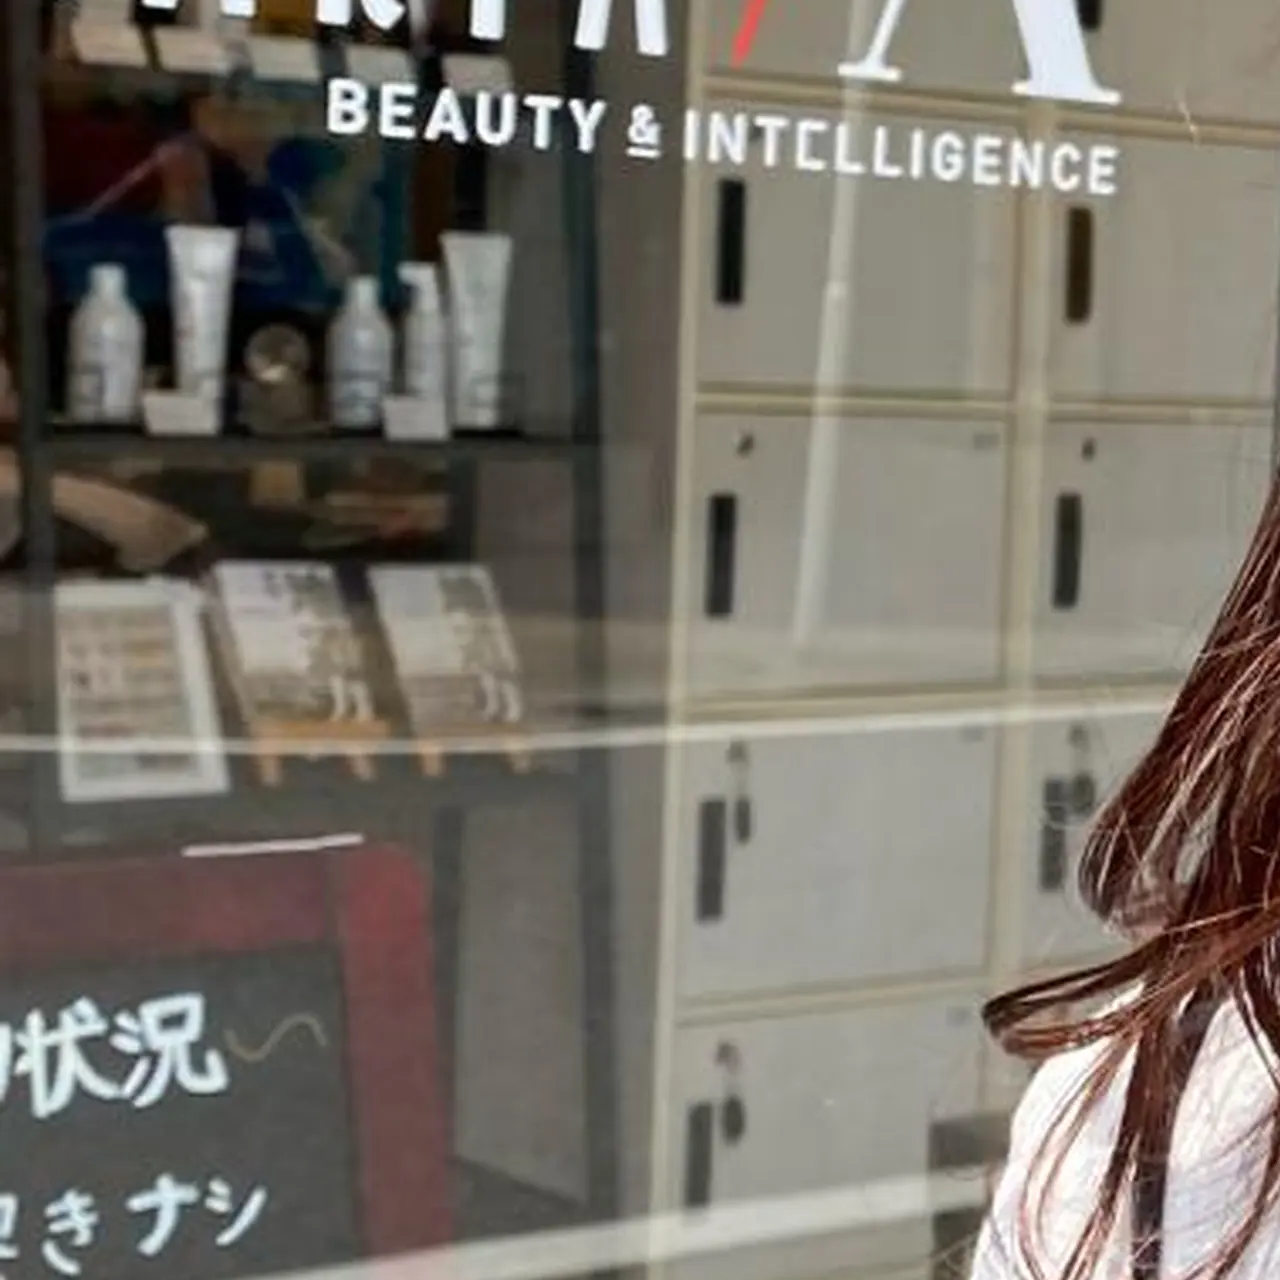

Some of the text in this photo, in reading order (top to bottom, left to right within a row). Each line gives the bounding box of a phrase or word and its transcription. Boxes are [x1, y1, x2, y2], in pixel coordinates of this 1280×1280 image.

[326, 77, 606, 153] BEAUTY
[625, 104, 662, 159] &
[0, 993, 229, 1119] 状況
